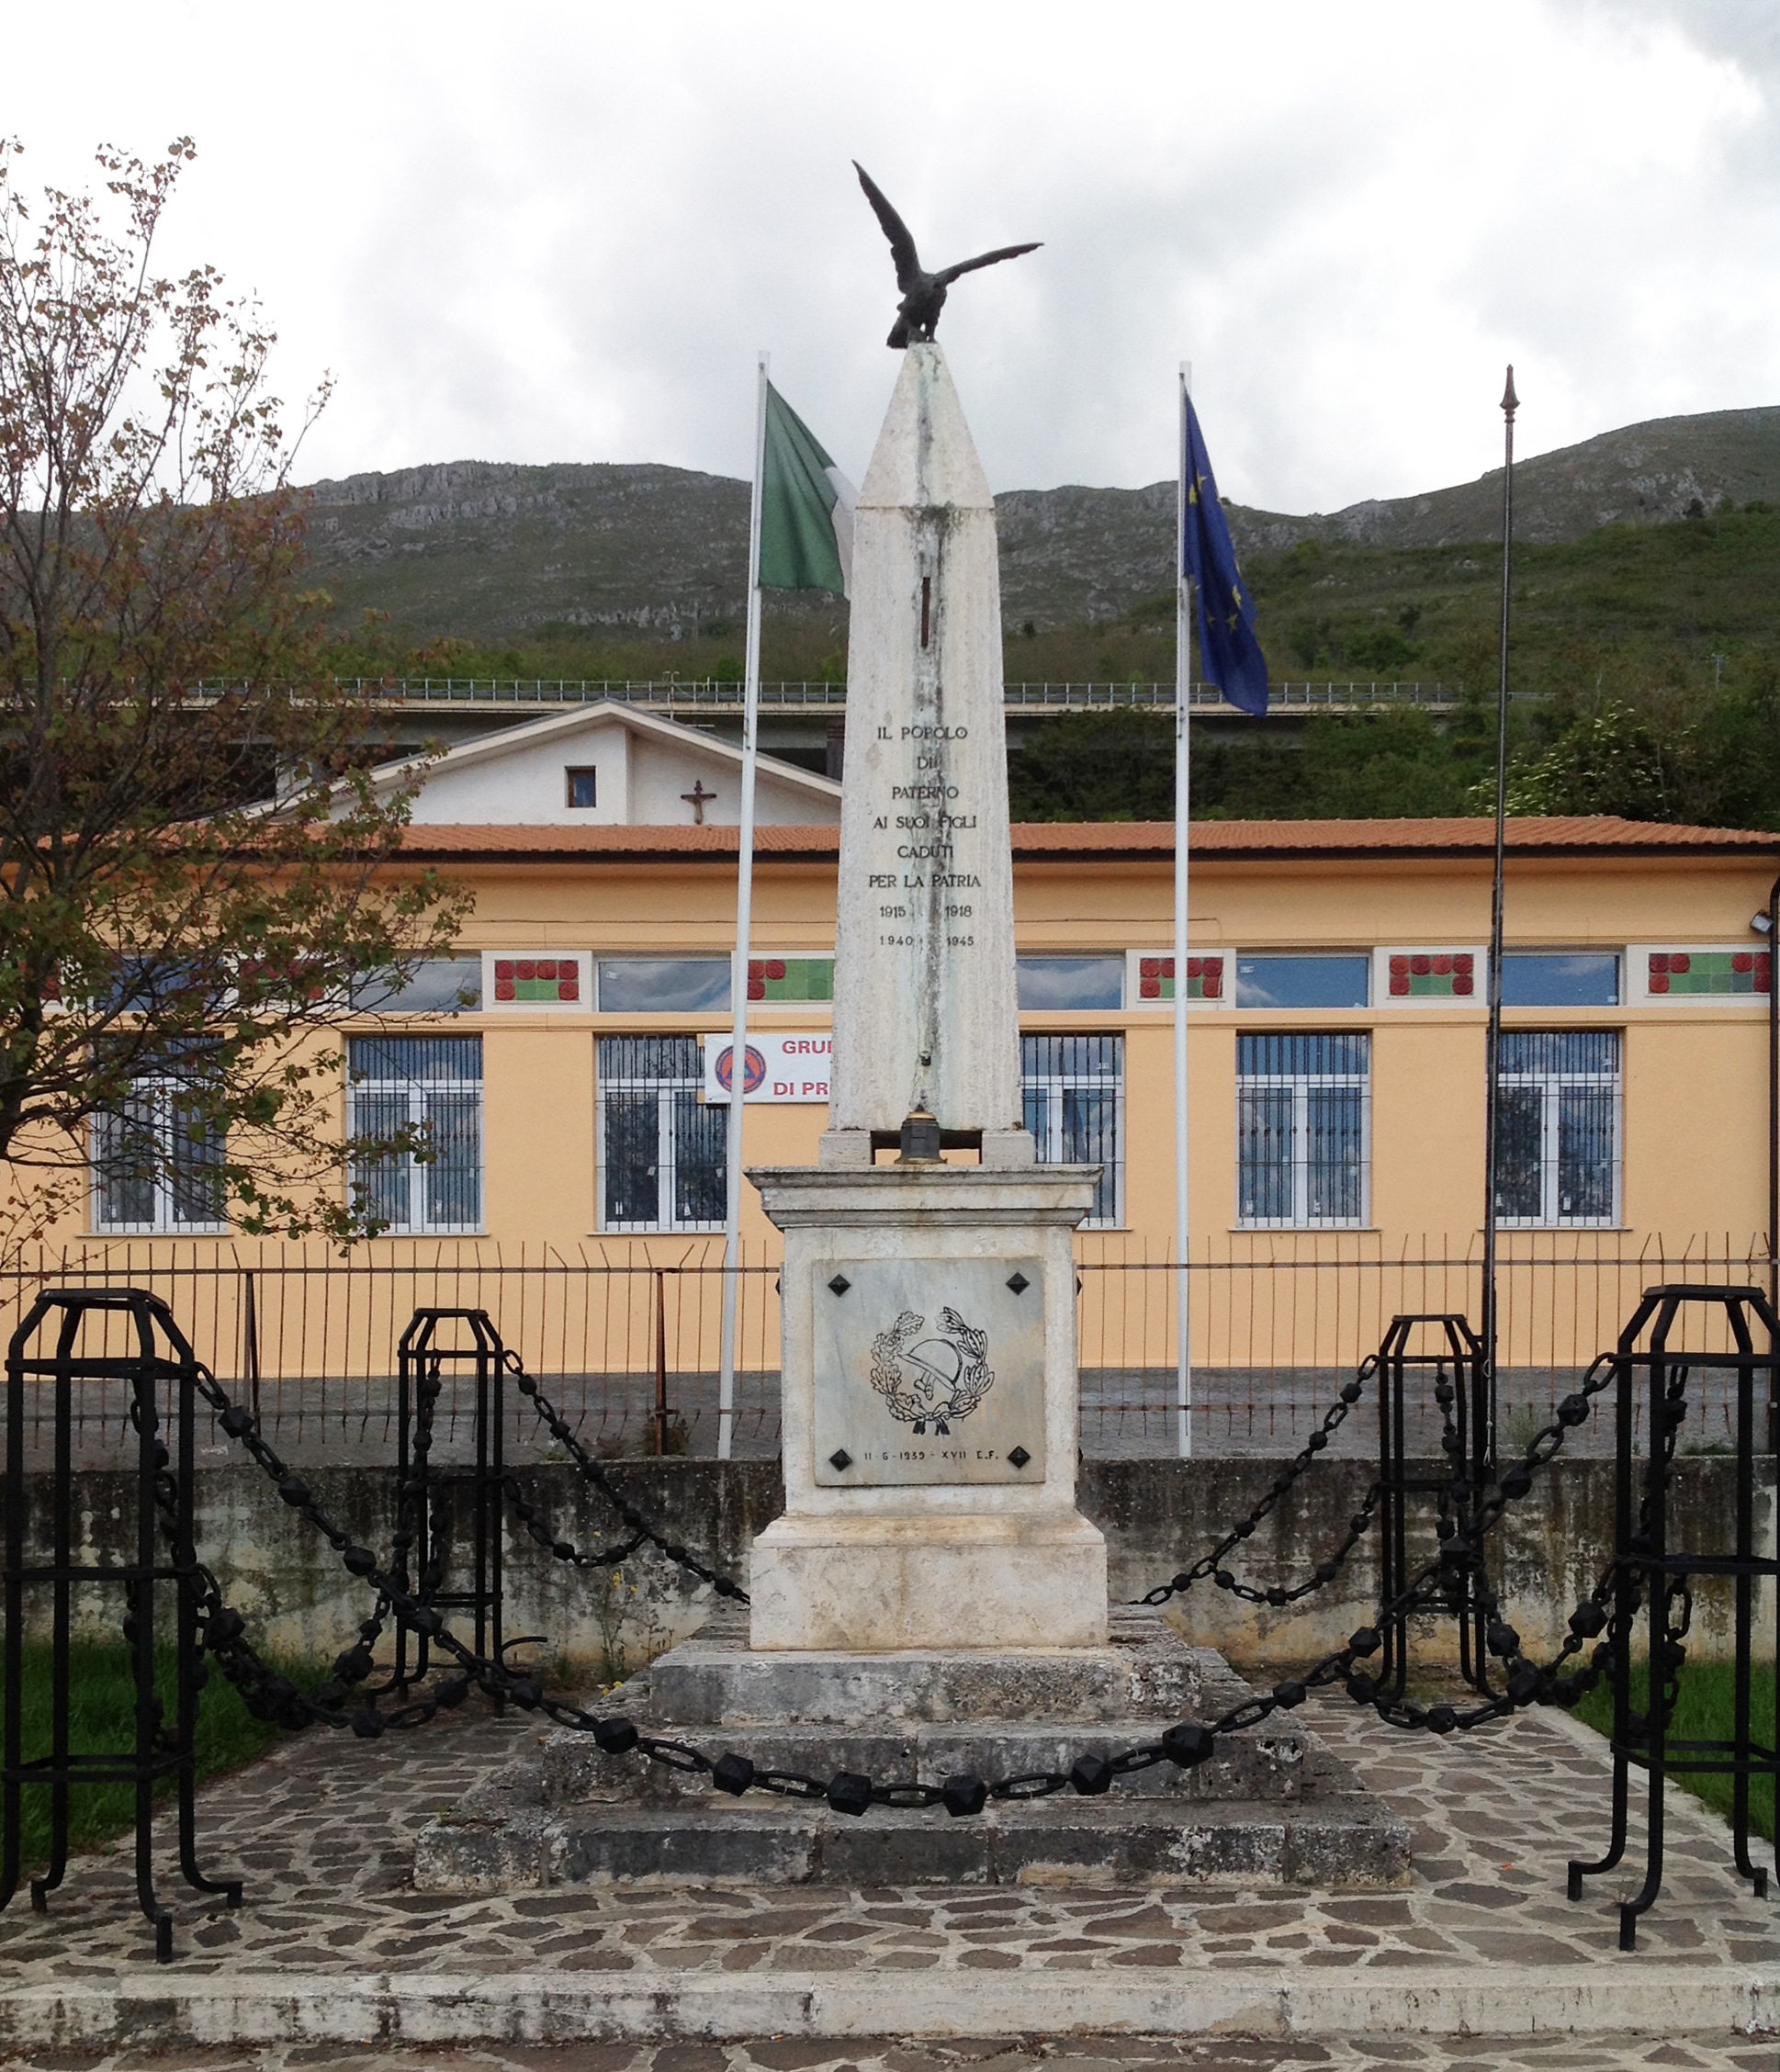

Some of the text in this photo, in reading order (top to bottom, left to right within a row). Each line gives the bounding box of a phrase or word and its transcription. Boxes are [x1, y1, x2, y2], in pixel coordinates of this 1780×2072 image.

[877, 726, 968, 740] IL POPOLO
[917, 757, 932, 770] DI
[892, 786, 959, 800] PATERNO
[873, 816, 977, 829] AI SUOI FIGLI
[896, 845, 954, 859] CADUTI
[869, 874, 982, 888] PER LA PATRIA
[879, 906, 972, 918] 1915 1918
[880, 935, 974, 947] 1940 1945
[773, 1082, 794, 1096] DI
